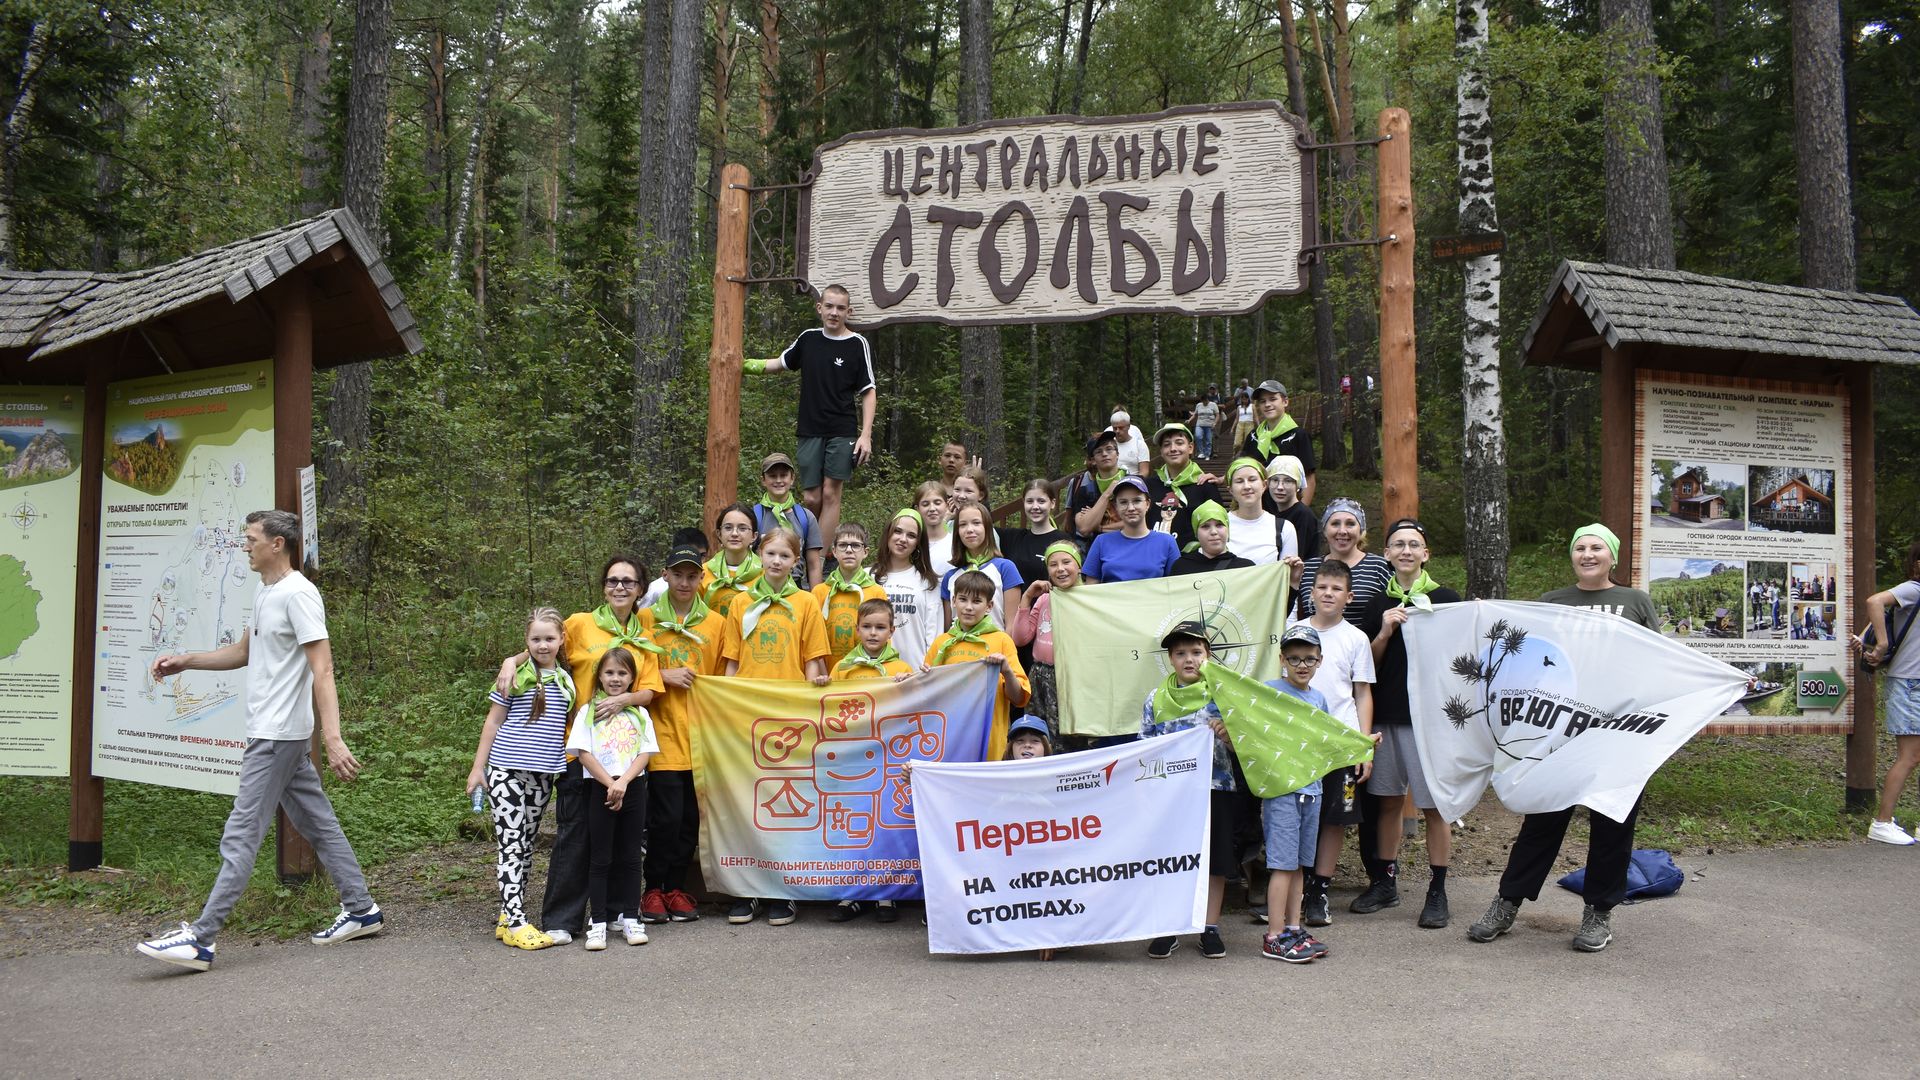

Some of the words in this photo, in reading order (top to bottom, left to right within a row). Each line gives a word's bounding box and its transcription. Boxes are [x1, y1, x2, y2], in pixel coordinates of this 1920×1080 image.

[883, 121, 1222, 203] ЦЕНТРАЛЬНЫЕ
[868, 188, 1226, 310] СТОЛБЫ
[1652, 387, 1755, 403] НАУЧНО-ПОЗНАВАТЕЛЬНЫЙ
[1758, 396, 1797, 406] КОМПЛЕКС
[6, 403, 48, 412] СТОЛБЫ»
[1688, 438, 1717, 446] НАУЧНЫЙ
[1718, 440, 1751, 448] СТАЦИОНАР
[1752, 443, 1785, 451] КОМПЛЕКСА
[107, 503, 145, 514] УВАЖАЕМЫЕ
[146, 502, 189, 512] ПОСЕТИТЕЛИ!
[106, 520, 131, 528] ОТКРЫТЫ
[132, 519, 152, 528] ТОЛЬКО
[157, 519, 188, 527] МАРШРУТА:
[1687, 532, 1715, 540] ГОСТЕВОЙ
[895, 604, 917, 615] MIND
[1801, 680, 1825, 696] 500
[1501, 688, 1560, 701] ГОСУДАРСЕННЫЙ
[1563, 697, 1615, 720] ПРИРОДНЫЙ
[118, 728, 146, 738] ОСТАЛЬНАЯ
[147, 732, 179, 741] ТЕРРИТОРИЯ
[180, 734, 213, 746] ВРЕМЕННО
[214, 739, 246, 749] ЗАКРЫТА!
[118, 745, 147, 755] ОБЕСПЕЧЕНИЯ
[164, 751, 200, 761] БЕЗОПАСНОСТИ,
[131, 757, 153, 766] ДЕРЕВЬЕВ
[158, 761, 179, 769] ВСТРЕЧИ
[185, 765, 211, 773] ОПАСНЫМИ
[213, 768, 234, 776] ДИКИМИ
[1167, 762, 1197, 772] СТОЛБЫ
[1059, 772, 1101, 784] ГРАНТЫ
[1056, 780, 1101, 793] ПЕРВЫХ
[955, 814, 1102, 856] Первые
[720, 856, 756, 868] ЦЕНТР
[867, 859, 921, 870] ОБРАЗОВ
[783, 874, 868, 886] БАРАБИНСКОГО
[869, 872, 917, 885] РАЙОНА
[963, 877, 996, 896] НА
[1009, 853, 1201, 890] «КРАСНОЯРСКИХ
[967, 899, 1086, 925] СТОЛБАХ»
